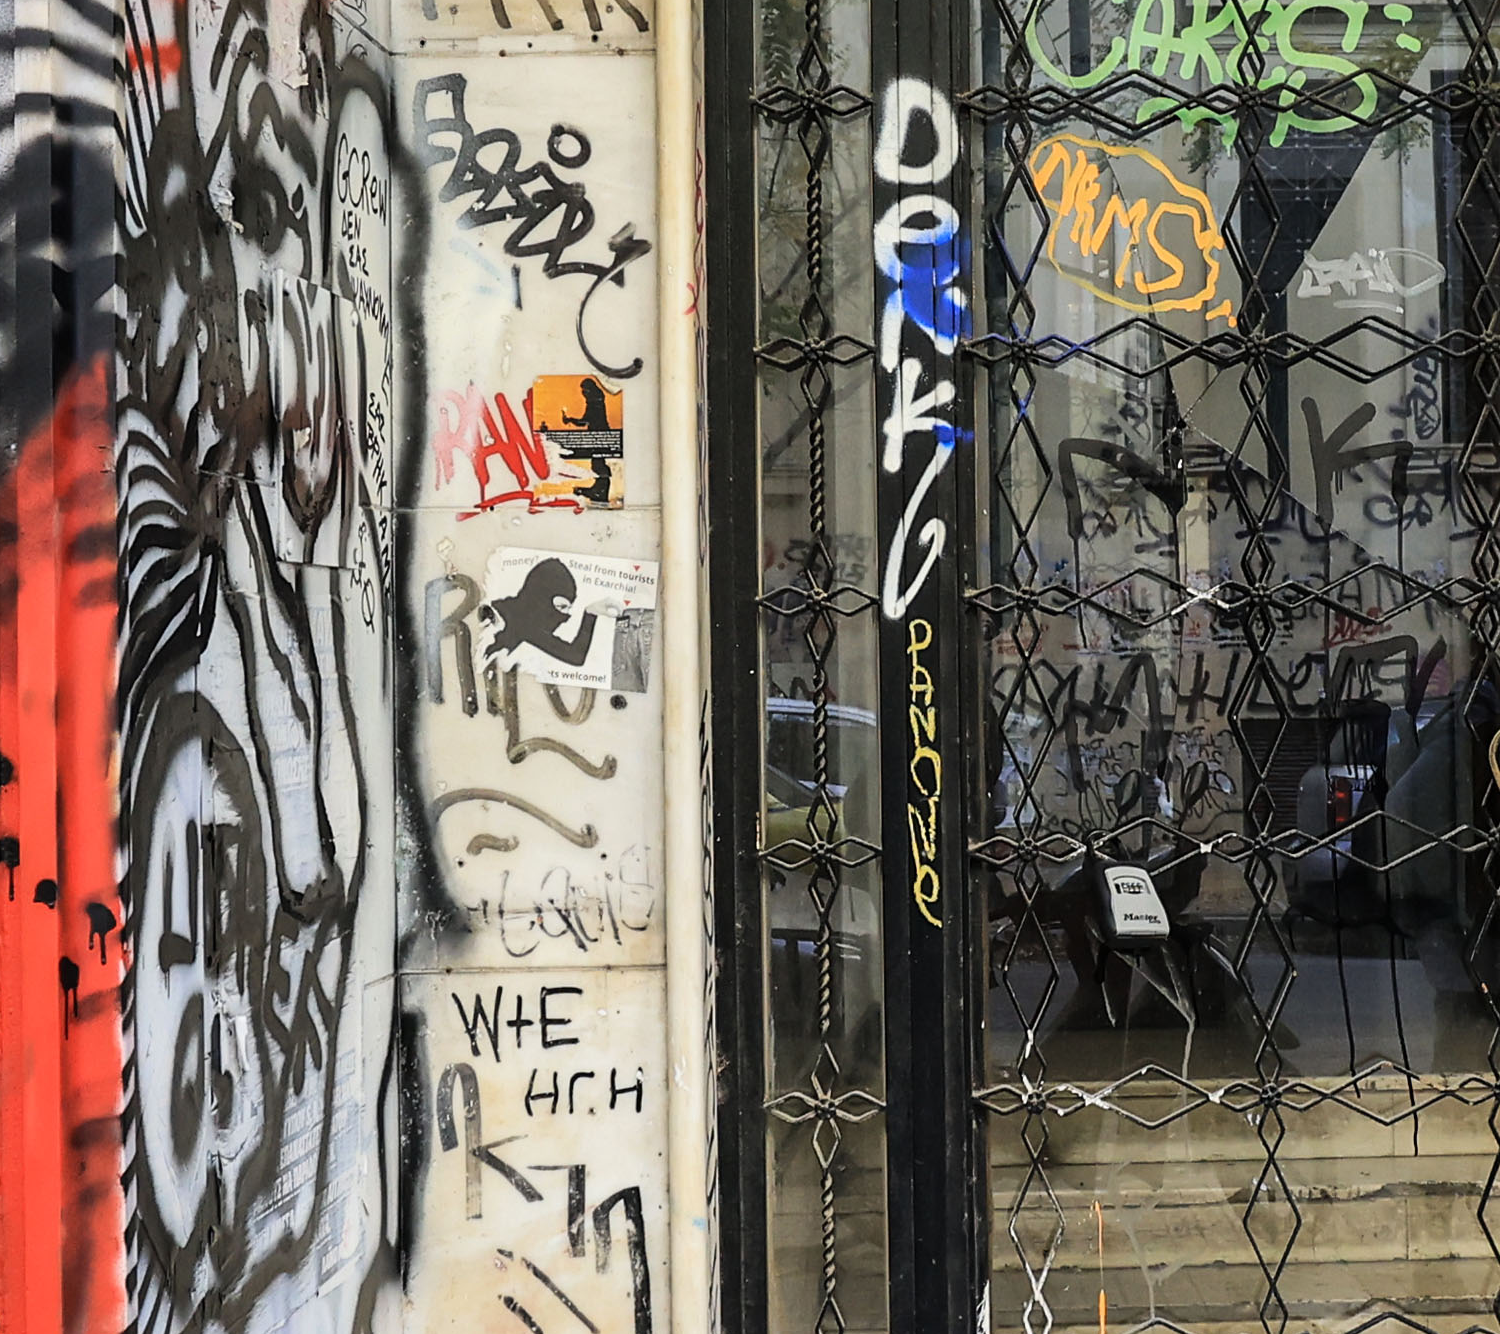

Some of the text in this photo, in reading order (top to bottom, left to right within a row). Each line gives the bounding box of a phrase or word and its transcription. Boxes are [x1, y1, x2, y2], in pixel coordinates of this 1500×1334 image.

[568, 559, 656, 586] Steal from tourists
[583, 575, 638, 595] in Exarchia!
[561, 671, 607, 684] welcome!
[1124, 913, 1158, 921] Master
